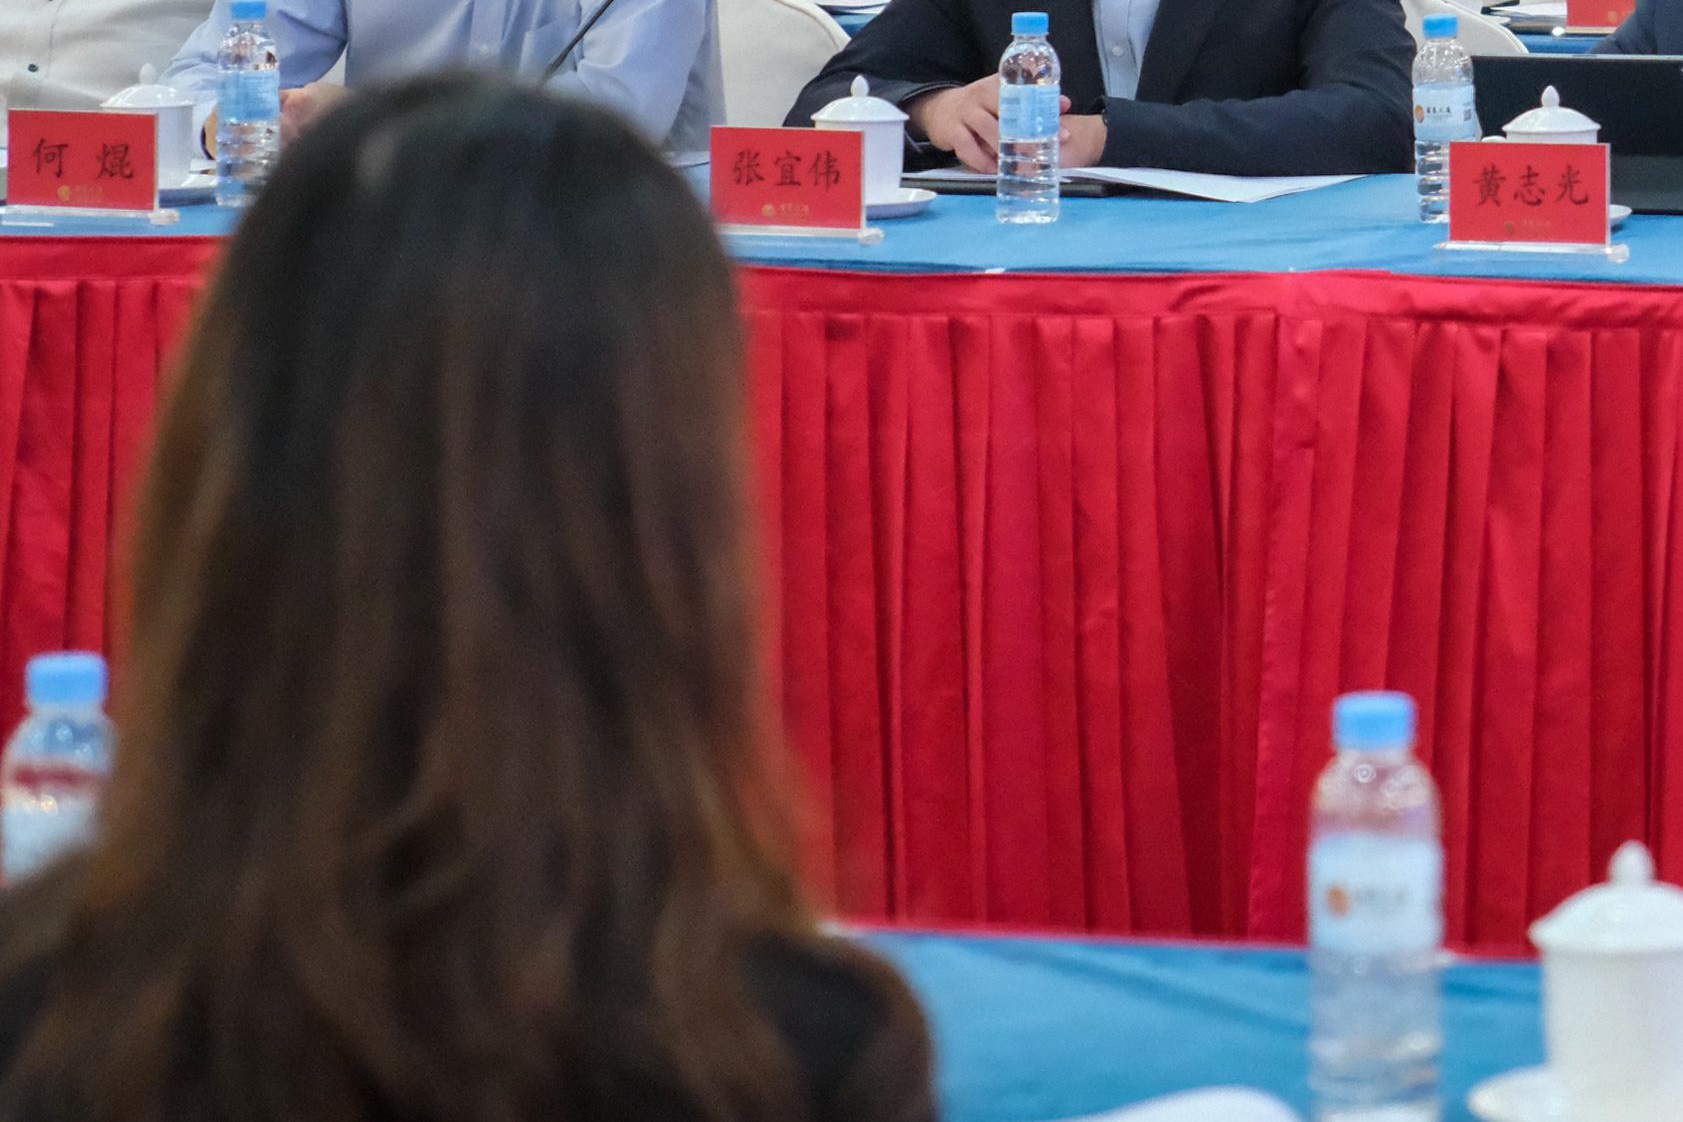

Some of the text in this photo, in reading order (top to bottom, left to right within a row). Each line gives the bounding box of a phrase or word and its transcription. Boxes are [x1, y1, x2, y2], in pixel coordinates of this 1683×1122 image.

[732, 149, 841, 192] 张宜伟
[1473, 164, 1590, 207] 黄志光
